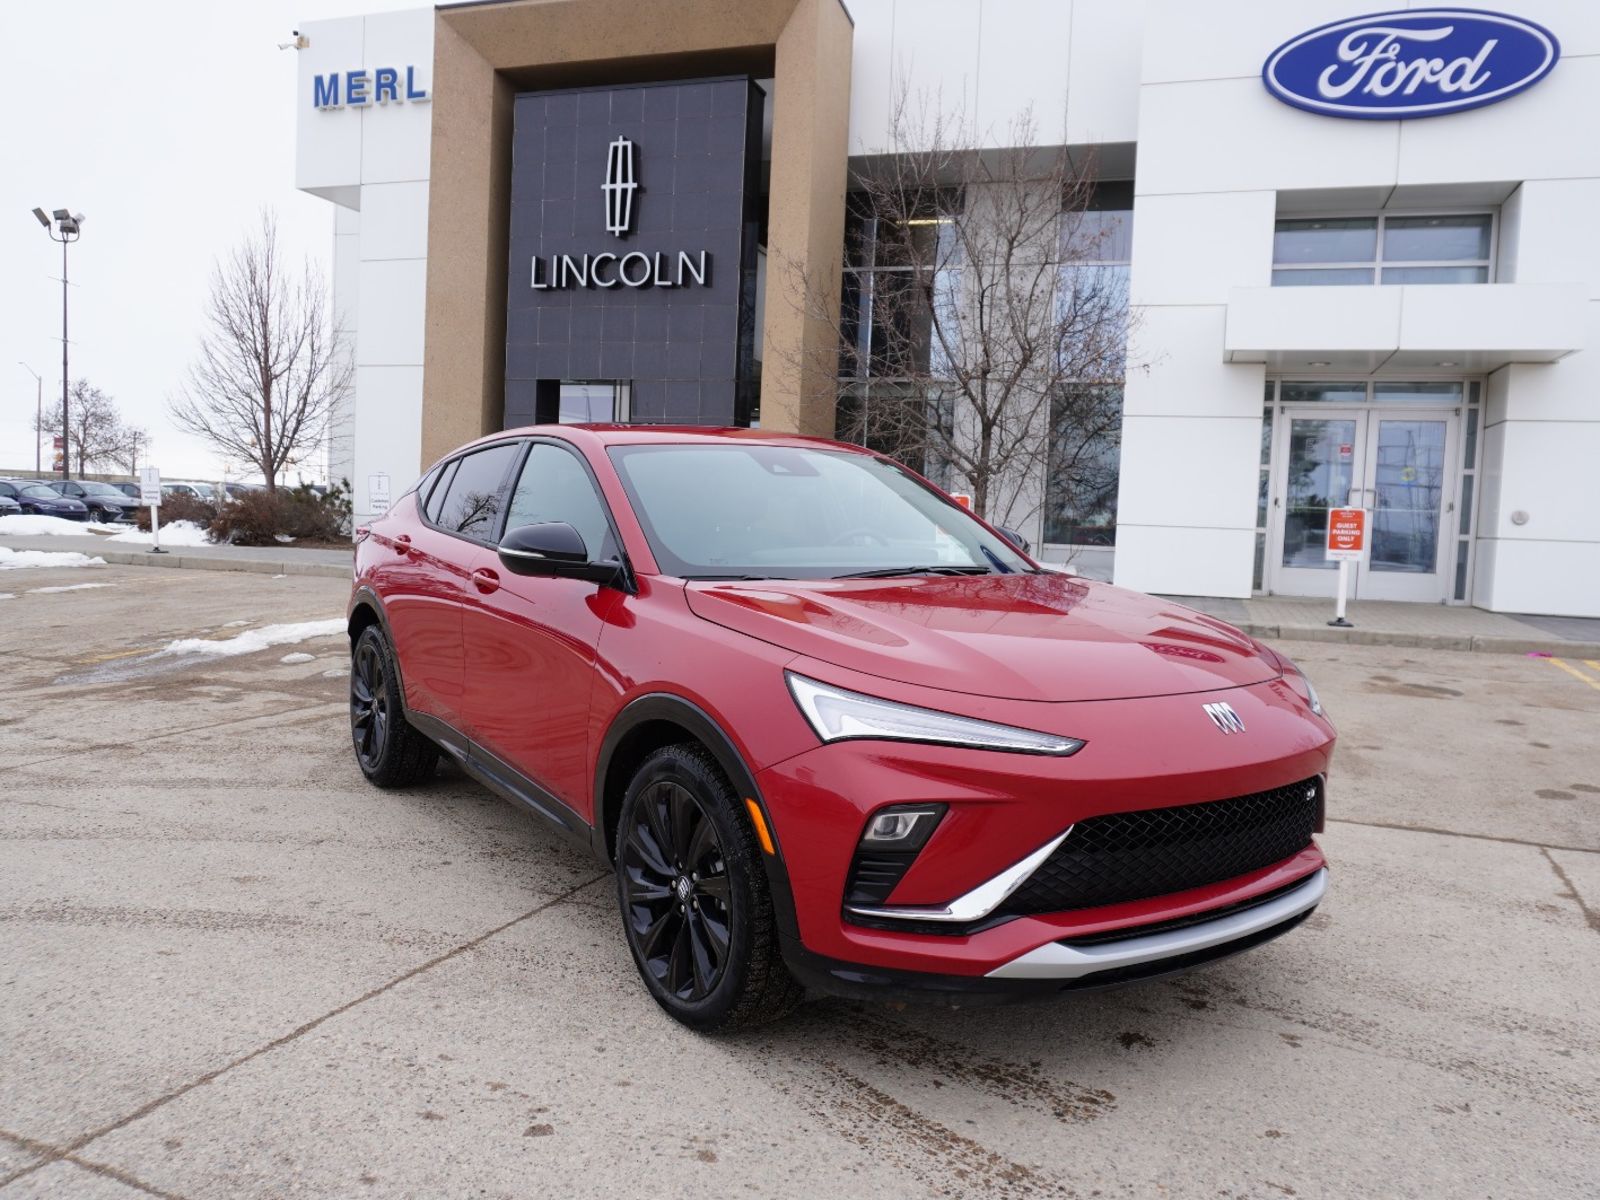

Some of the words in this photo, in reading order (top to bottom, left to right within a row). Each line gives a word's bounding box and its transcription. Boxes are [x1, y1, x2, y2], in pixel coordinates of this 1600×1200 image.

[1318, 25, 1499, 98] Ford
[314, 65, 426, 107] MERL
[530, 250, 706, 288] LINCOLN
